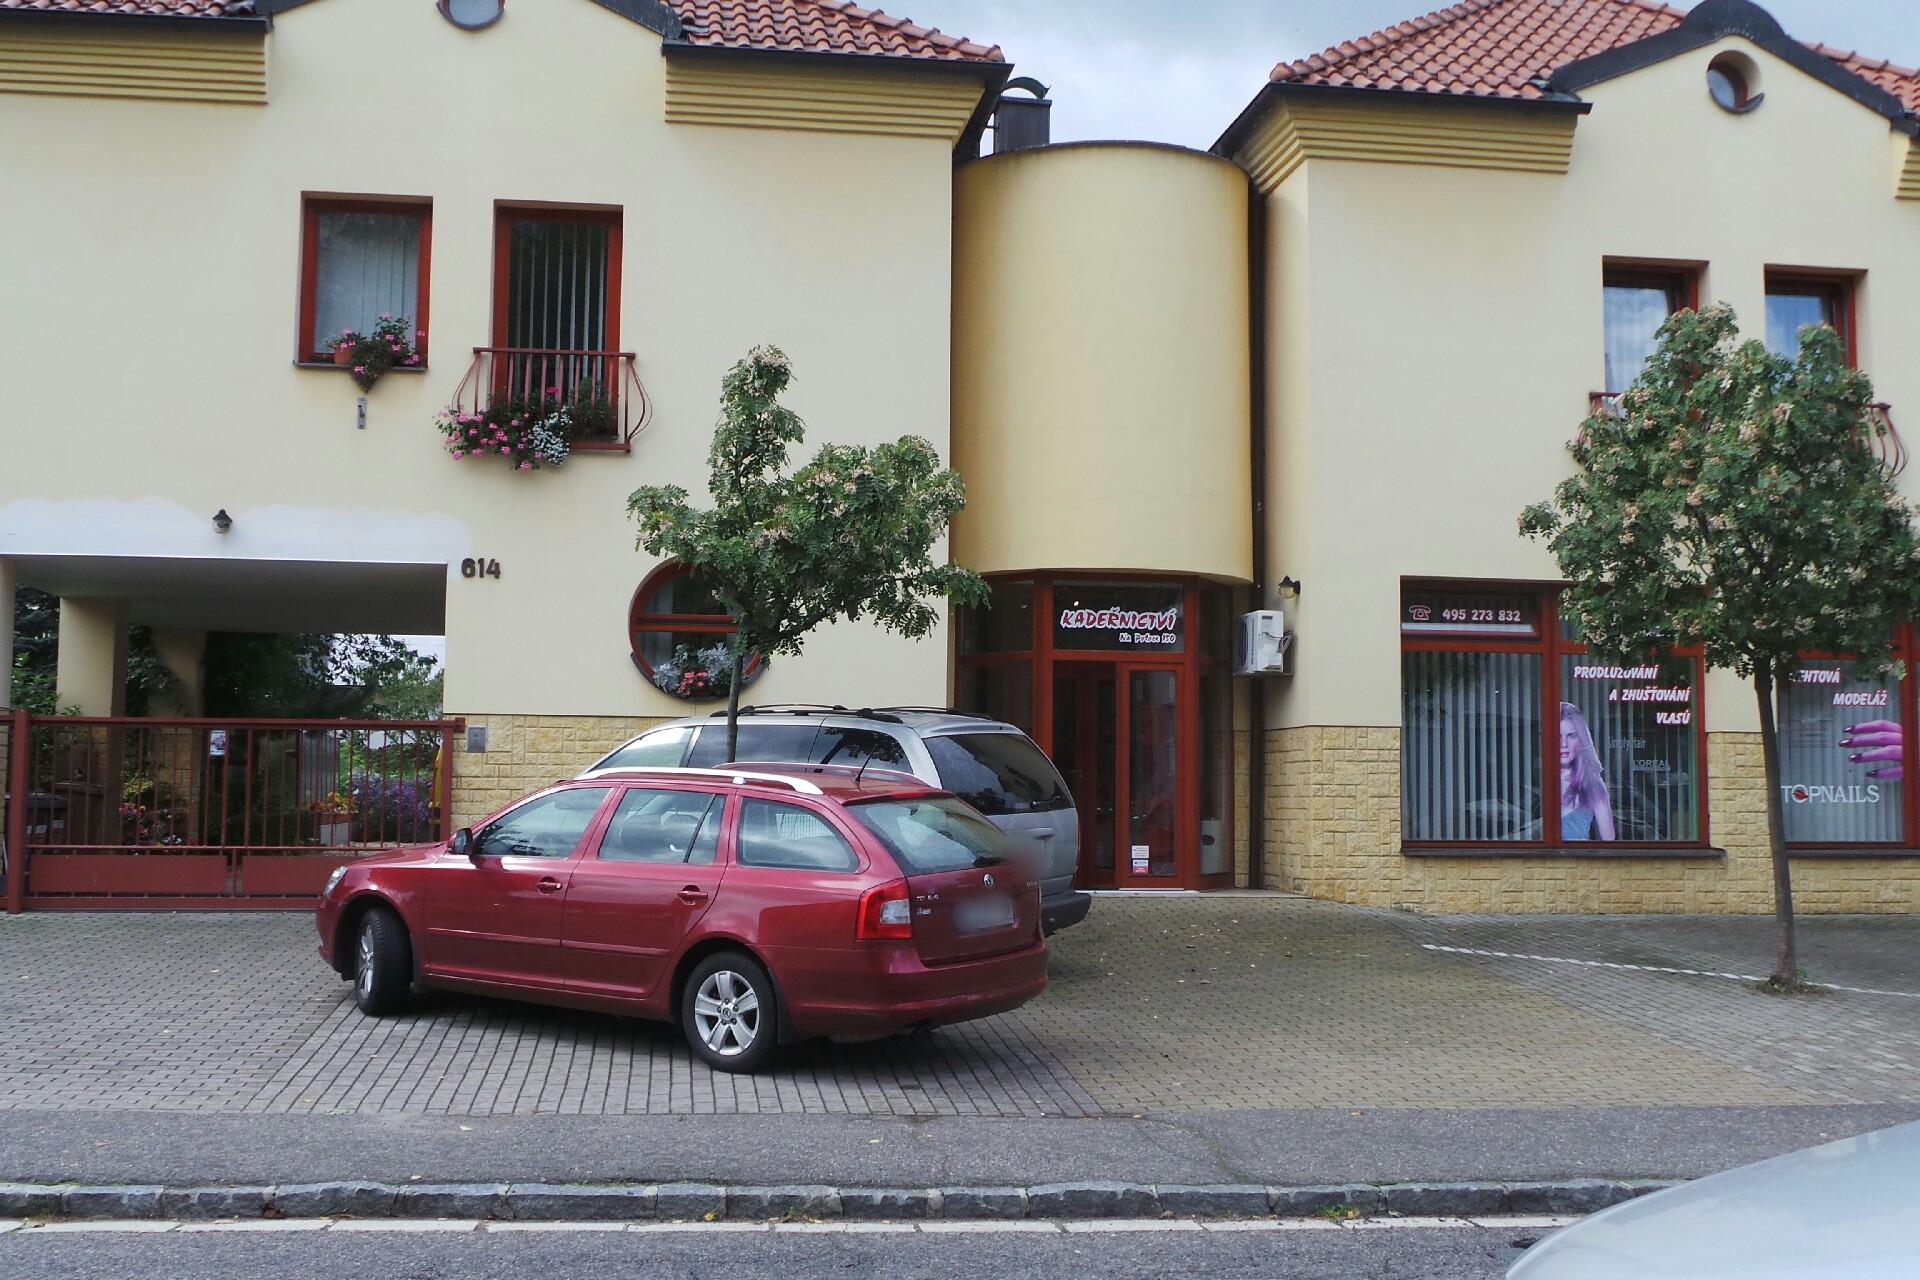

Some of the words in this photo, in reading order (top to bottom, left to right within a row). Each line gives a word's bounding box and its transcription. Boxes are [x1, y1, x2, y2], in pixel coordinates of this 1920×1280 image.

[461, 557, 501, 579] 614
[1060, 607, 1177, 631] KADEŘNICTVÍ
[1442, 608, 1466, 620] 495
[1471, 609, 1493, 621] 273
[1498, 609, 1521, 622] 832
[1161, 633, 1176, 643] 150
[1609, 688, 1617, 701] A
[1621, 686, 1691, 702] ZHUŠŤOVÁNÍ
[1832, 689, 1888, 706] MODELÁŽ
[1656, 710, 1691, 724] VLASŮ
[1780, 784, 1880, 804] TOPNAILS
